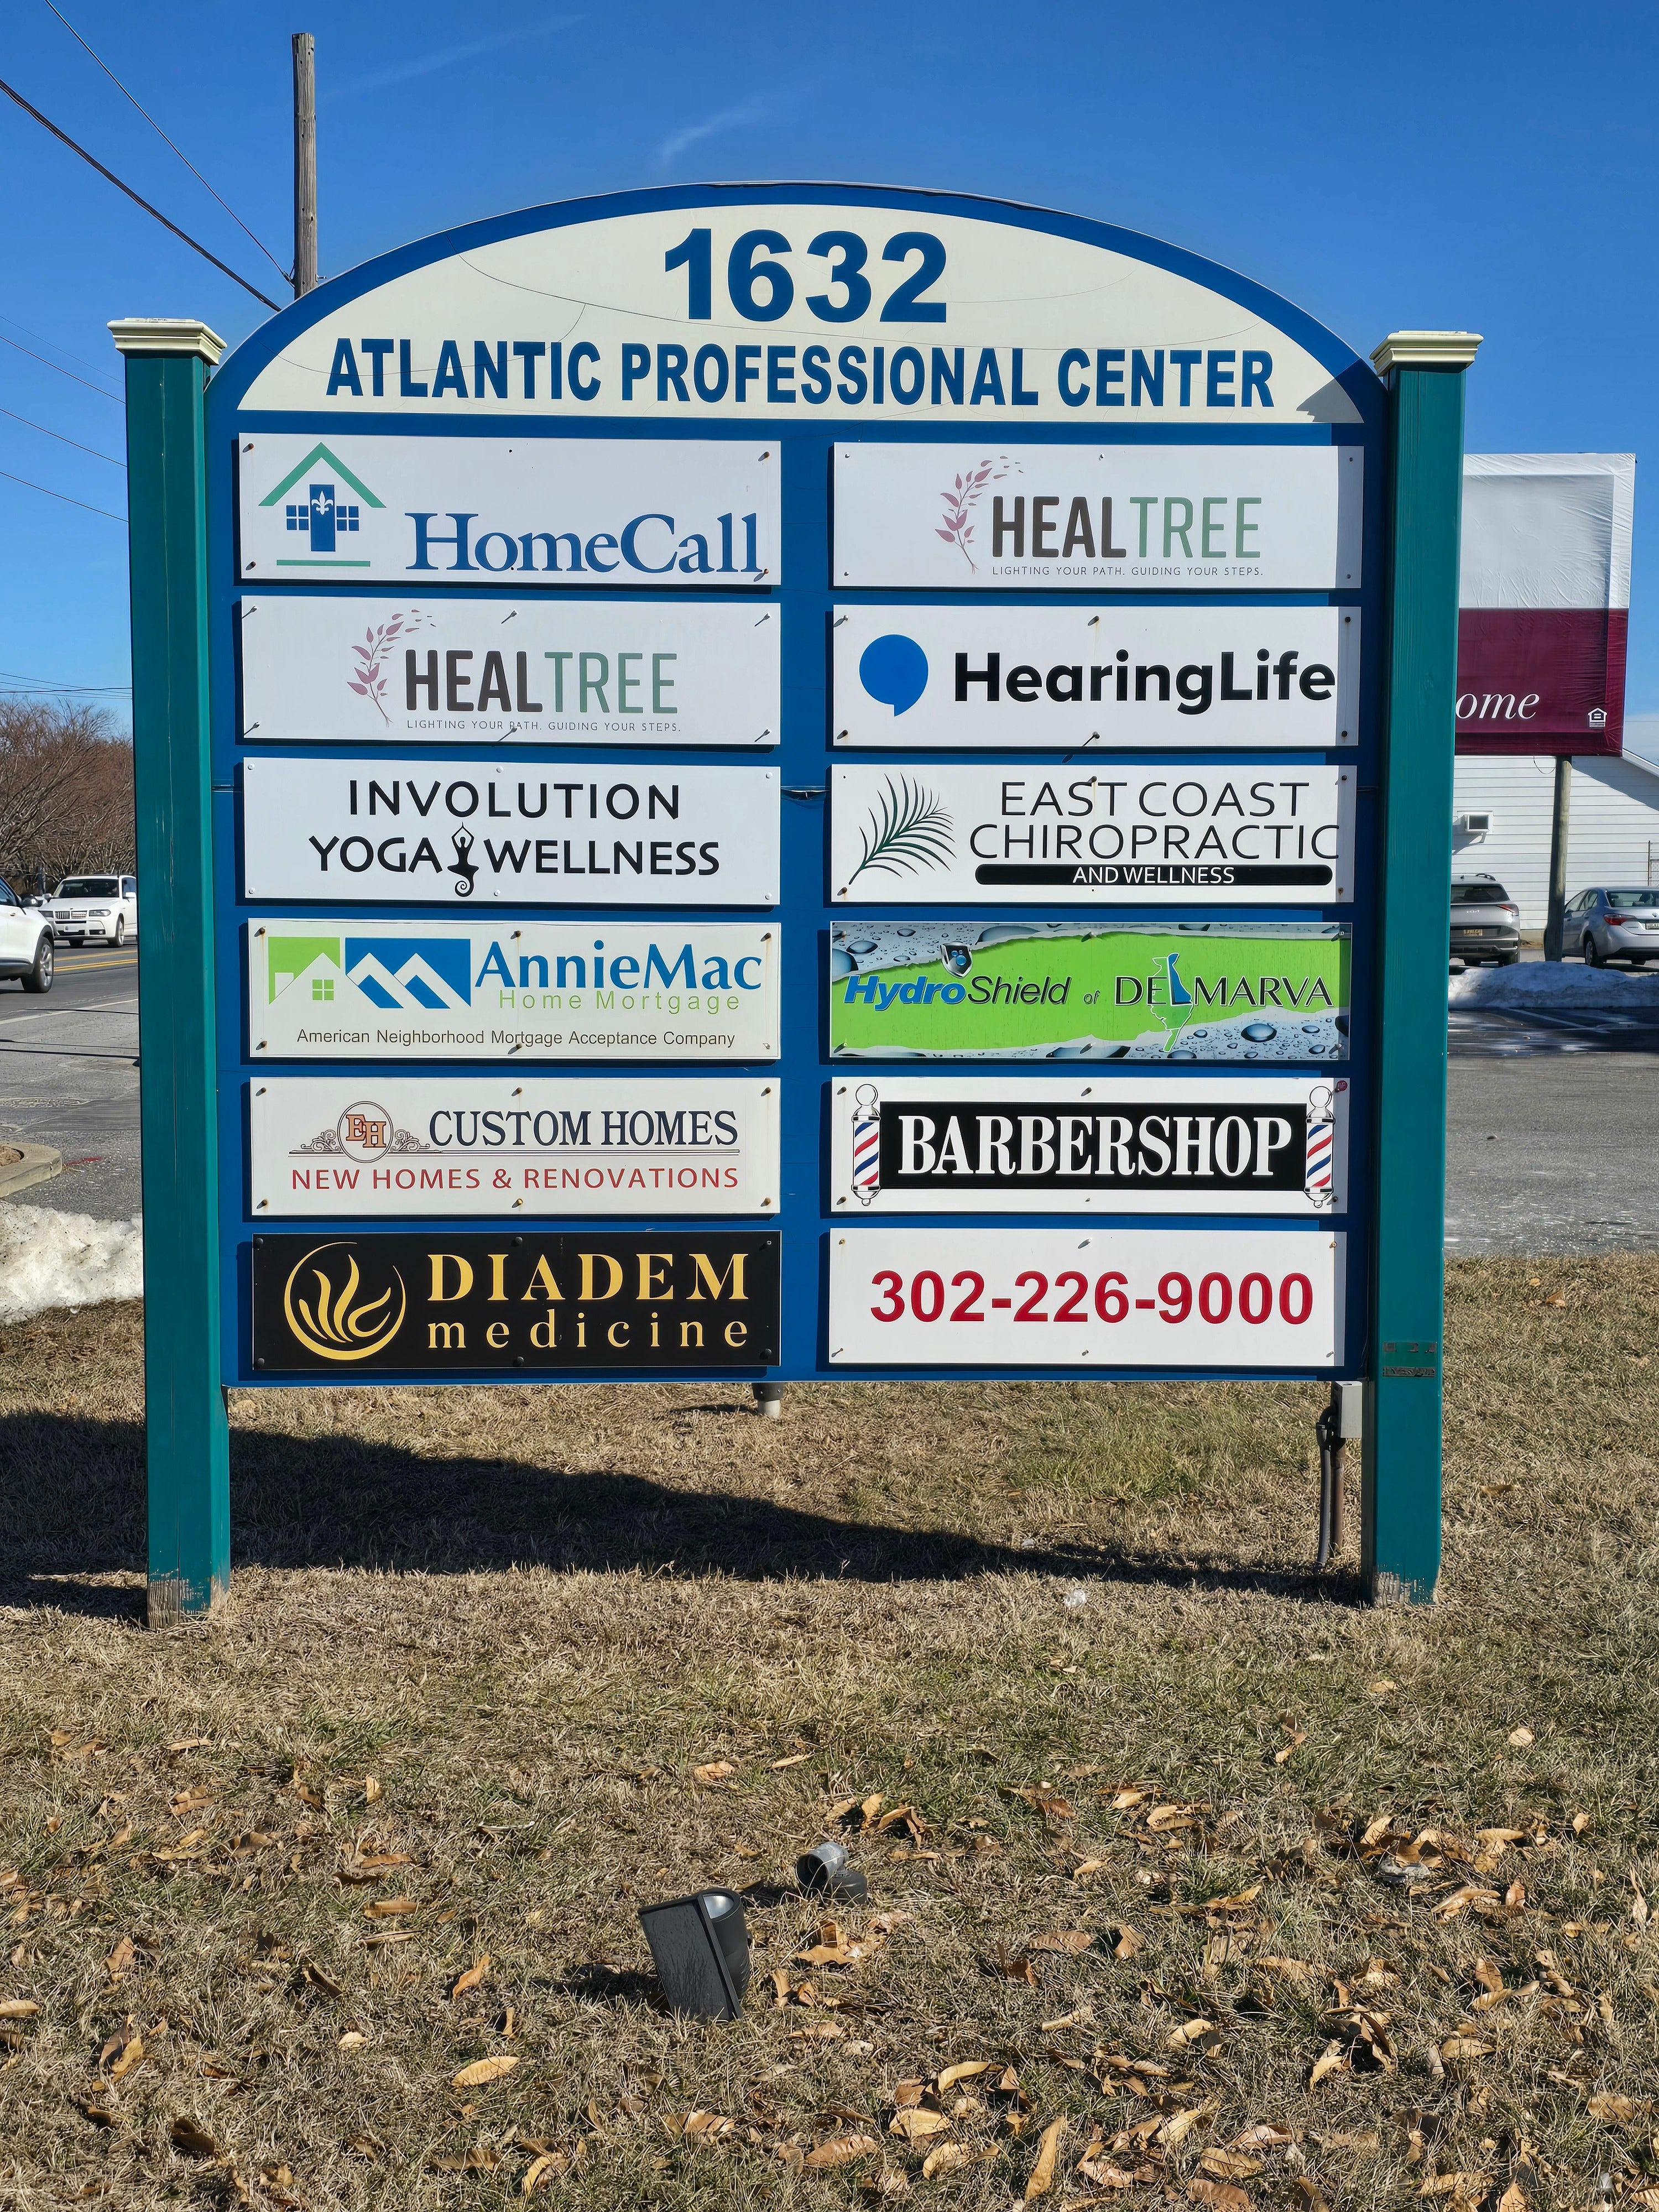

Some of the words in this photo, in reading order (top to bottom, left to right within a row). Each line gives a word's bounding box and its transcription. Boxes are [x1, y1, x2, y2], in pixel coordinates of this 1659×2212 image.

[665, 228, 946, 323] 1632
[326, 338, 601, 400] ATLANTIC
[622, 343, 1038, 405] PROFESSIONAL
[1058, 348, 1274, 407] CENTER
[405, 513, 764, 572] HomeCall
[954, 649, 1335, 716] HearingLife
[549, 722, 597, 731] GUIDING
[350, 780, 679, 820] INVOLUTION
[1001, 781, 1127, 816] EAST
[1139, 782, 1309, 816] COAST
[309, 836, 442, 873] YOGA
[484, 839, 719, 875] WELLNESS
[969, 824, 1339, 859] CHIROPRACTIC
[1072, 867, 1119, 884] AND
[1121, 867, 1235, 884] WELLNESS
[475, 940, 762, 990] AnnieMac
[499, 990, 582, 1009] Home
[596, 990, 740, 1015] Mortgage
[843, 975, 1072, 1011] HydroShield
[1083, 990, 1100, 1005] of
[1115, 962, 1334, 1006] DELMARVA
[298, 1029, 369, 1042] American
[378, 1030, 483, 1046] Neighborhood
[492, 1030, 562, 1047] Mortgage
[569, 1031, 656, 1047] Acceptance
[664, 1032, 734, 1048] Company
[429, 1110, 589, 1146] CUSTOM
[601, 1110, 737, 1145] HOMES
[898, 1116, 1291, 1176] BARBERSHOP
[293, 1170, 359, 1189] NEW
[373, 1169, 479, 1189] HOMES
[493, 1169, 511, 1188] &
[525, 1168, 737, 1188] RENOVATIONS
[427, 1254, 748, 1301] DIADEM
[871, 1271, 1312, 1324] 302-226-9000
[428, 1309, 747, 1348] medicine
